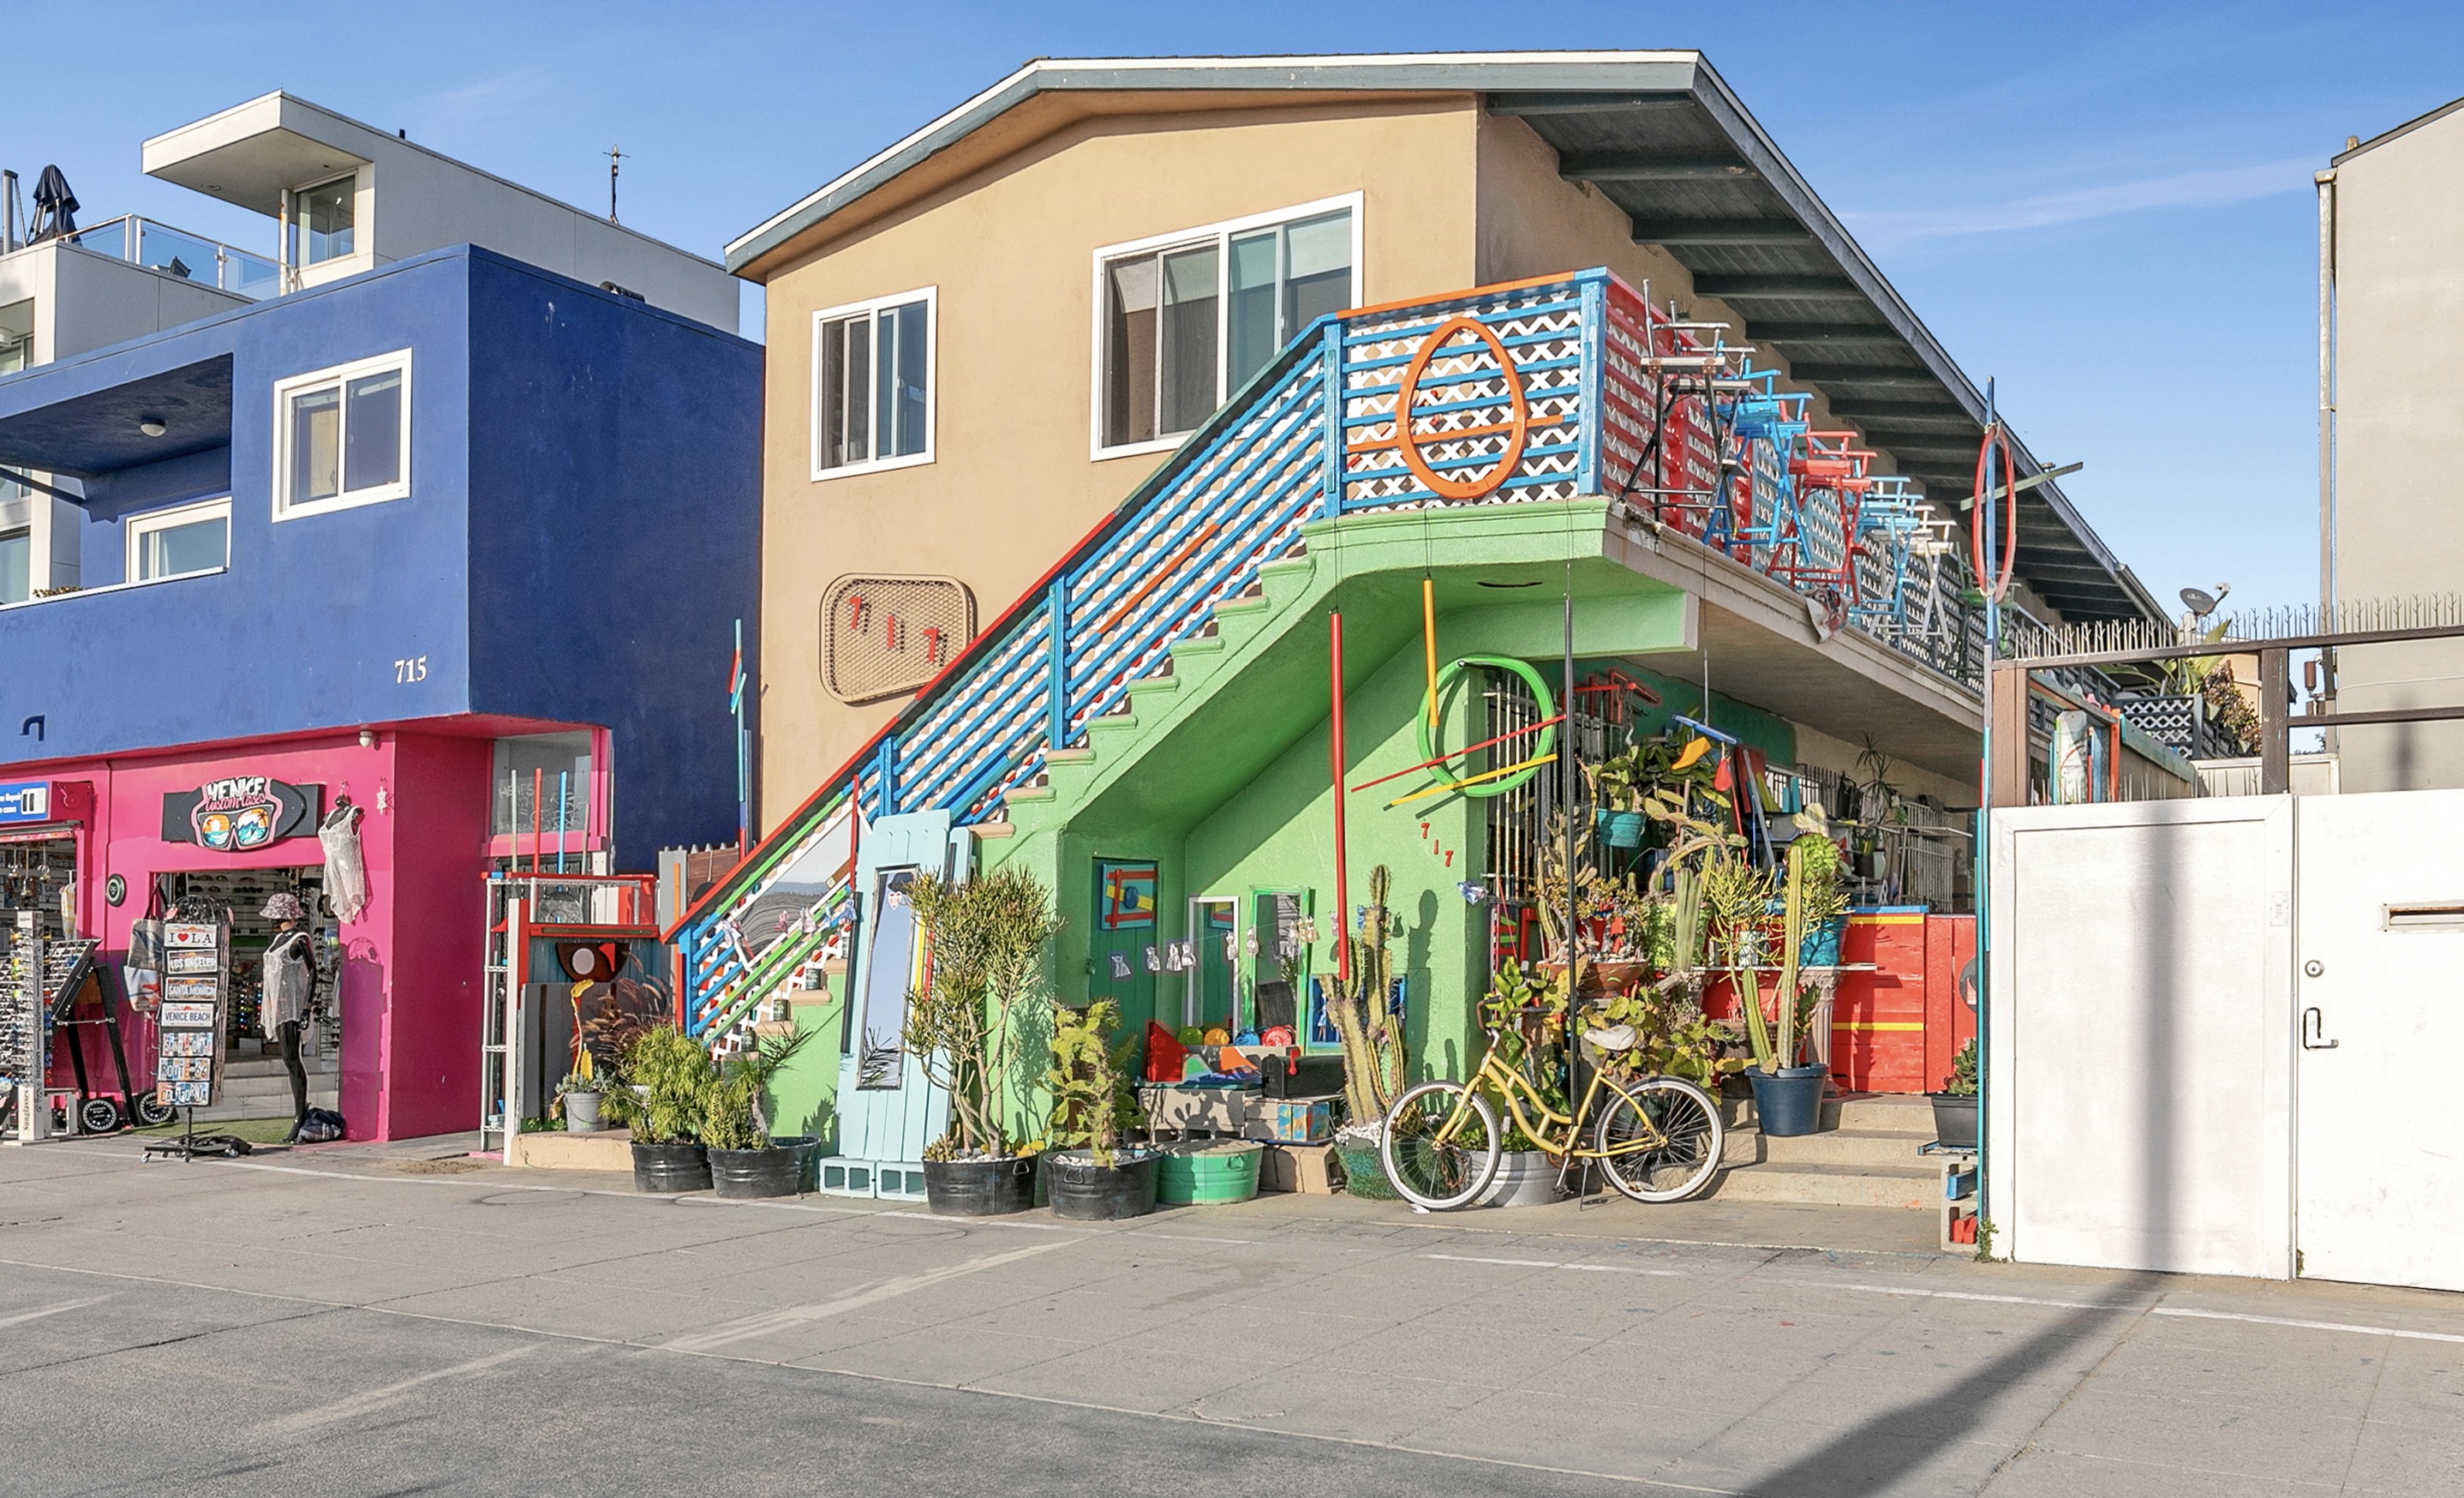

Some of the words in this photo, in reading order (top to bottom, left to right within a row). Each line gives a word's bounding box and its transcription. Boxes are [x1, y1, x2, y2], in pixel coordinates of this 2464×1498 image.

[848, 596, 940, 662] 717
[394, 655, 427, 684] 715
[206, 776, 266, 801] VENICE
[205, 795, 240, 812] Custom
[240, 791, 266, 806] Cases
[1420, 822, 1454, 867] 717
[169, 932, 176, 943] I
[170, 958, 184, 969] LOS
[183, 956, 215, 968] ANGELES
[164, 1011, 188, 1022] VENICE
[189, 1011, 211, 1022] BEACH
[160, 1064, 189, 1079] ROUTE
[194, 1063, 206, 1078] 66
